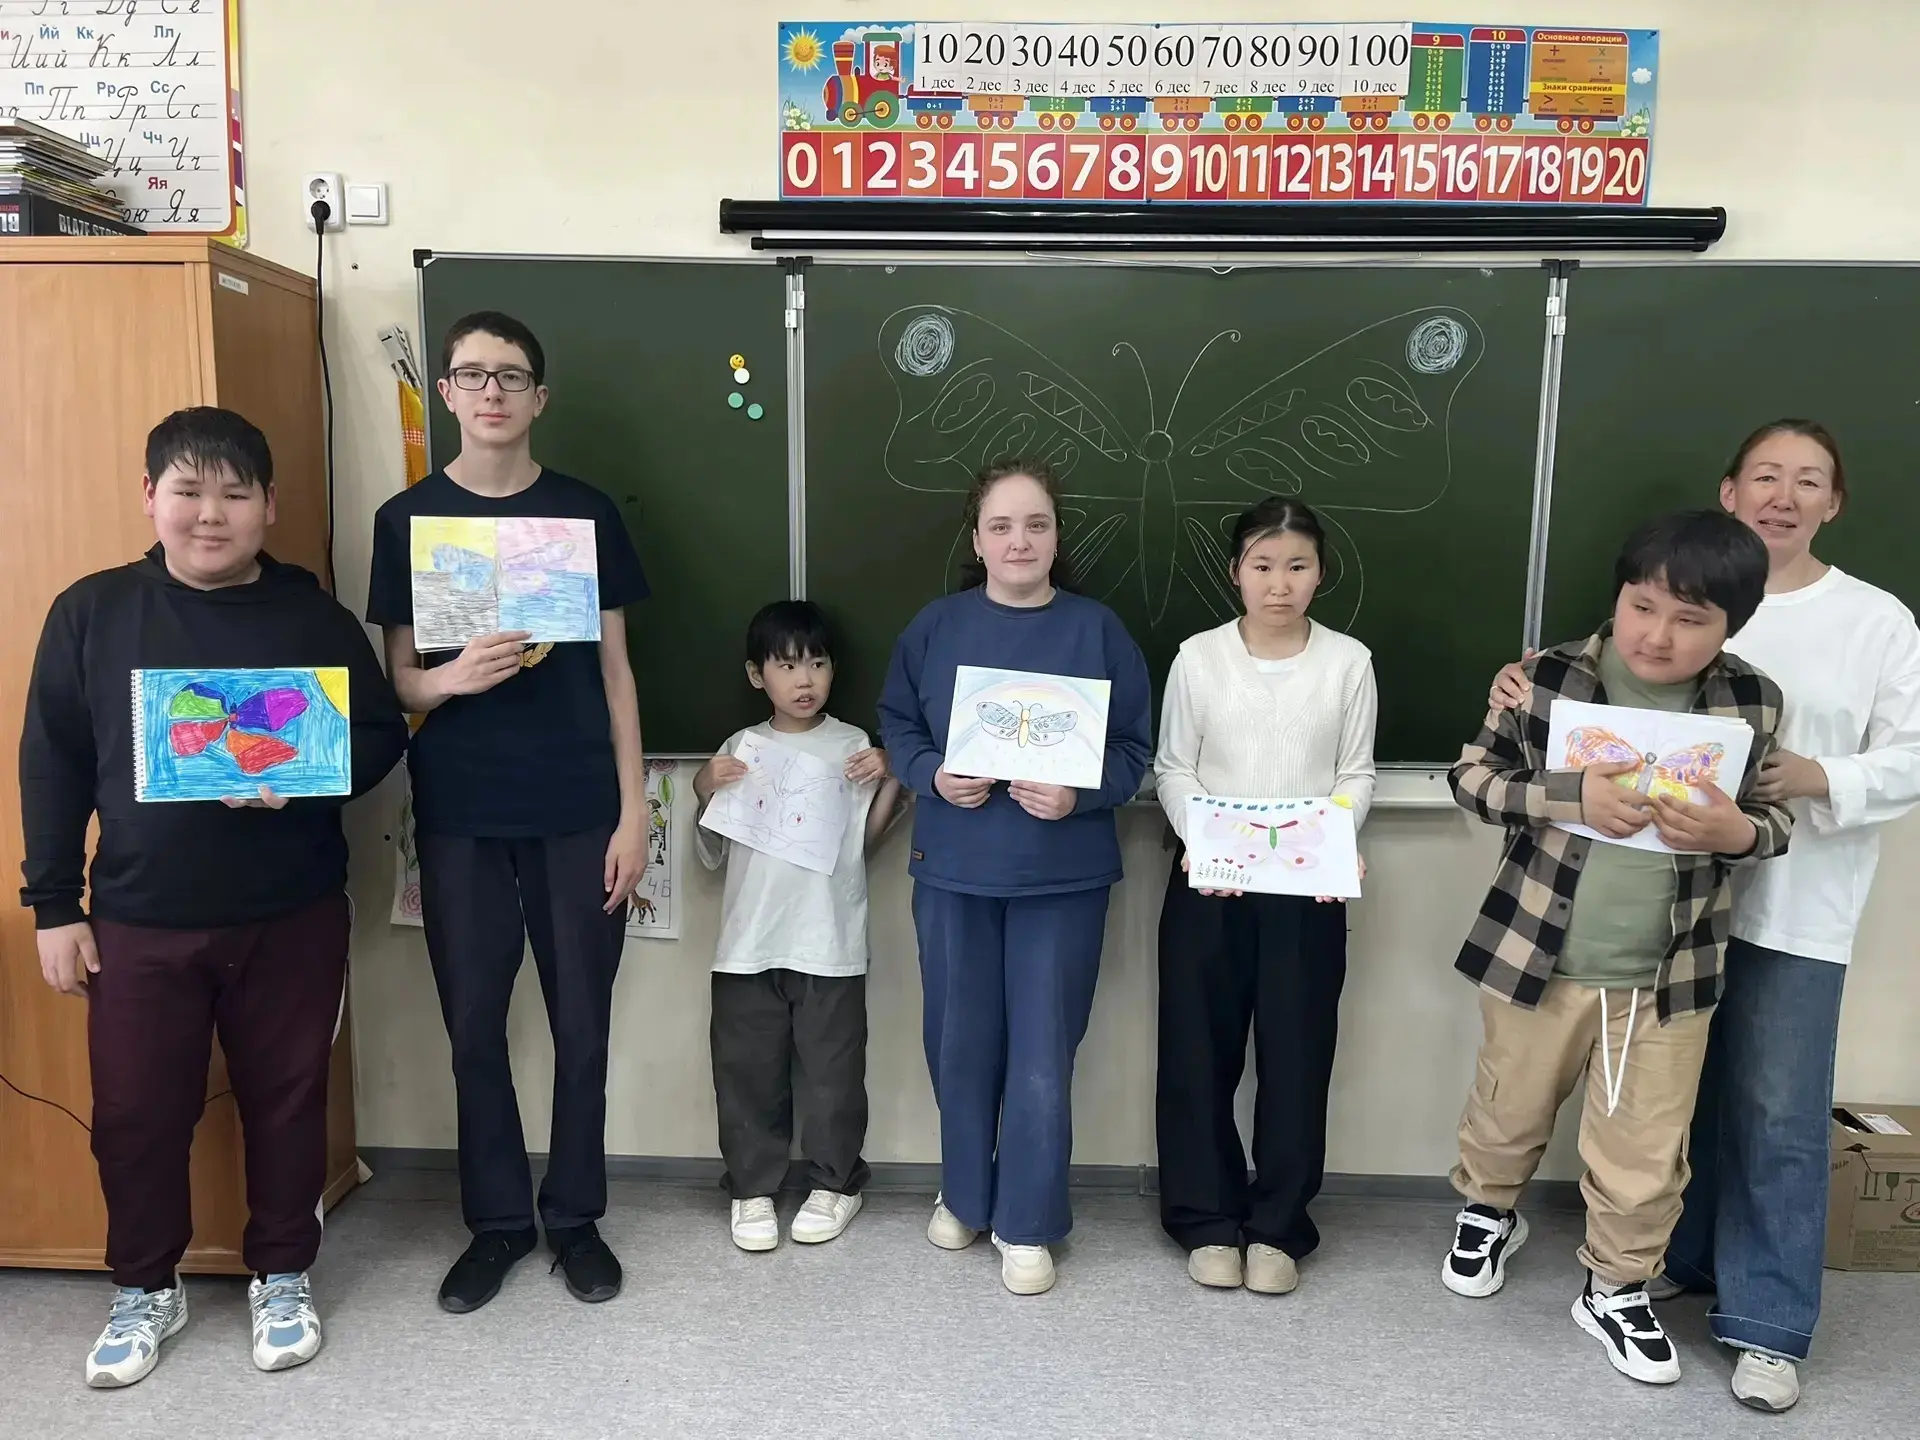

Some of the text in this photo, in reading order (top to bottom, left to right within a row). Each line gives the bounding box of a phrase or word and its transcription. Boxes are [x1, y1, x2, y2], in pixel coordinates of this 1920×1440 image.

[1432, 35, 1440, 45] 9
[1492, 30, 1506, 40] 10
[1537, 33, 1622, 43] Основные операции
[921, 33, 1408, 67] 10 20 30 40 50 60 70 80 90 100
[921, 77, 955, 89] 1 дес
[967, 77, 1002, 91] 2 дес
[1013, 79, 1049, 93] 3 дес
[1060, 80, 1096, 93] 4 дес
[1108, 80, 1144, 93] 5 дес
[1155, 80, 1191, 93] 6 дес
[1203, 81, 1238, 93] 7 дес
[1250, 80, 1286, 93] 8 дес
[1299, 80, 1335, 93] 9 дес
[1353, 80, 1397, 92] 10 дес
[1568, 85, 1613, 93] сравнения
[788, 141, 1643, 195] 0 1 2 3 4 5 6 7 8 9 10 11 12 13 14 15 16 17 18 19 20
